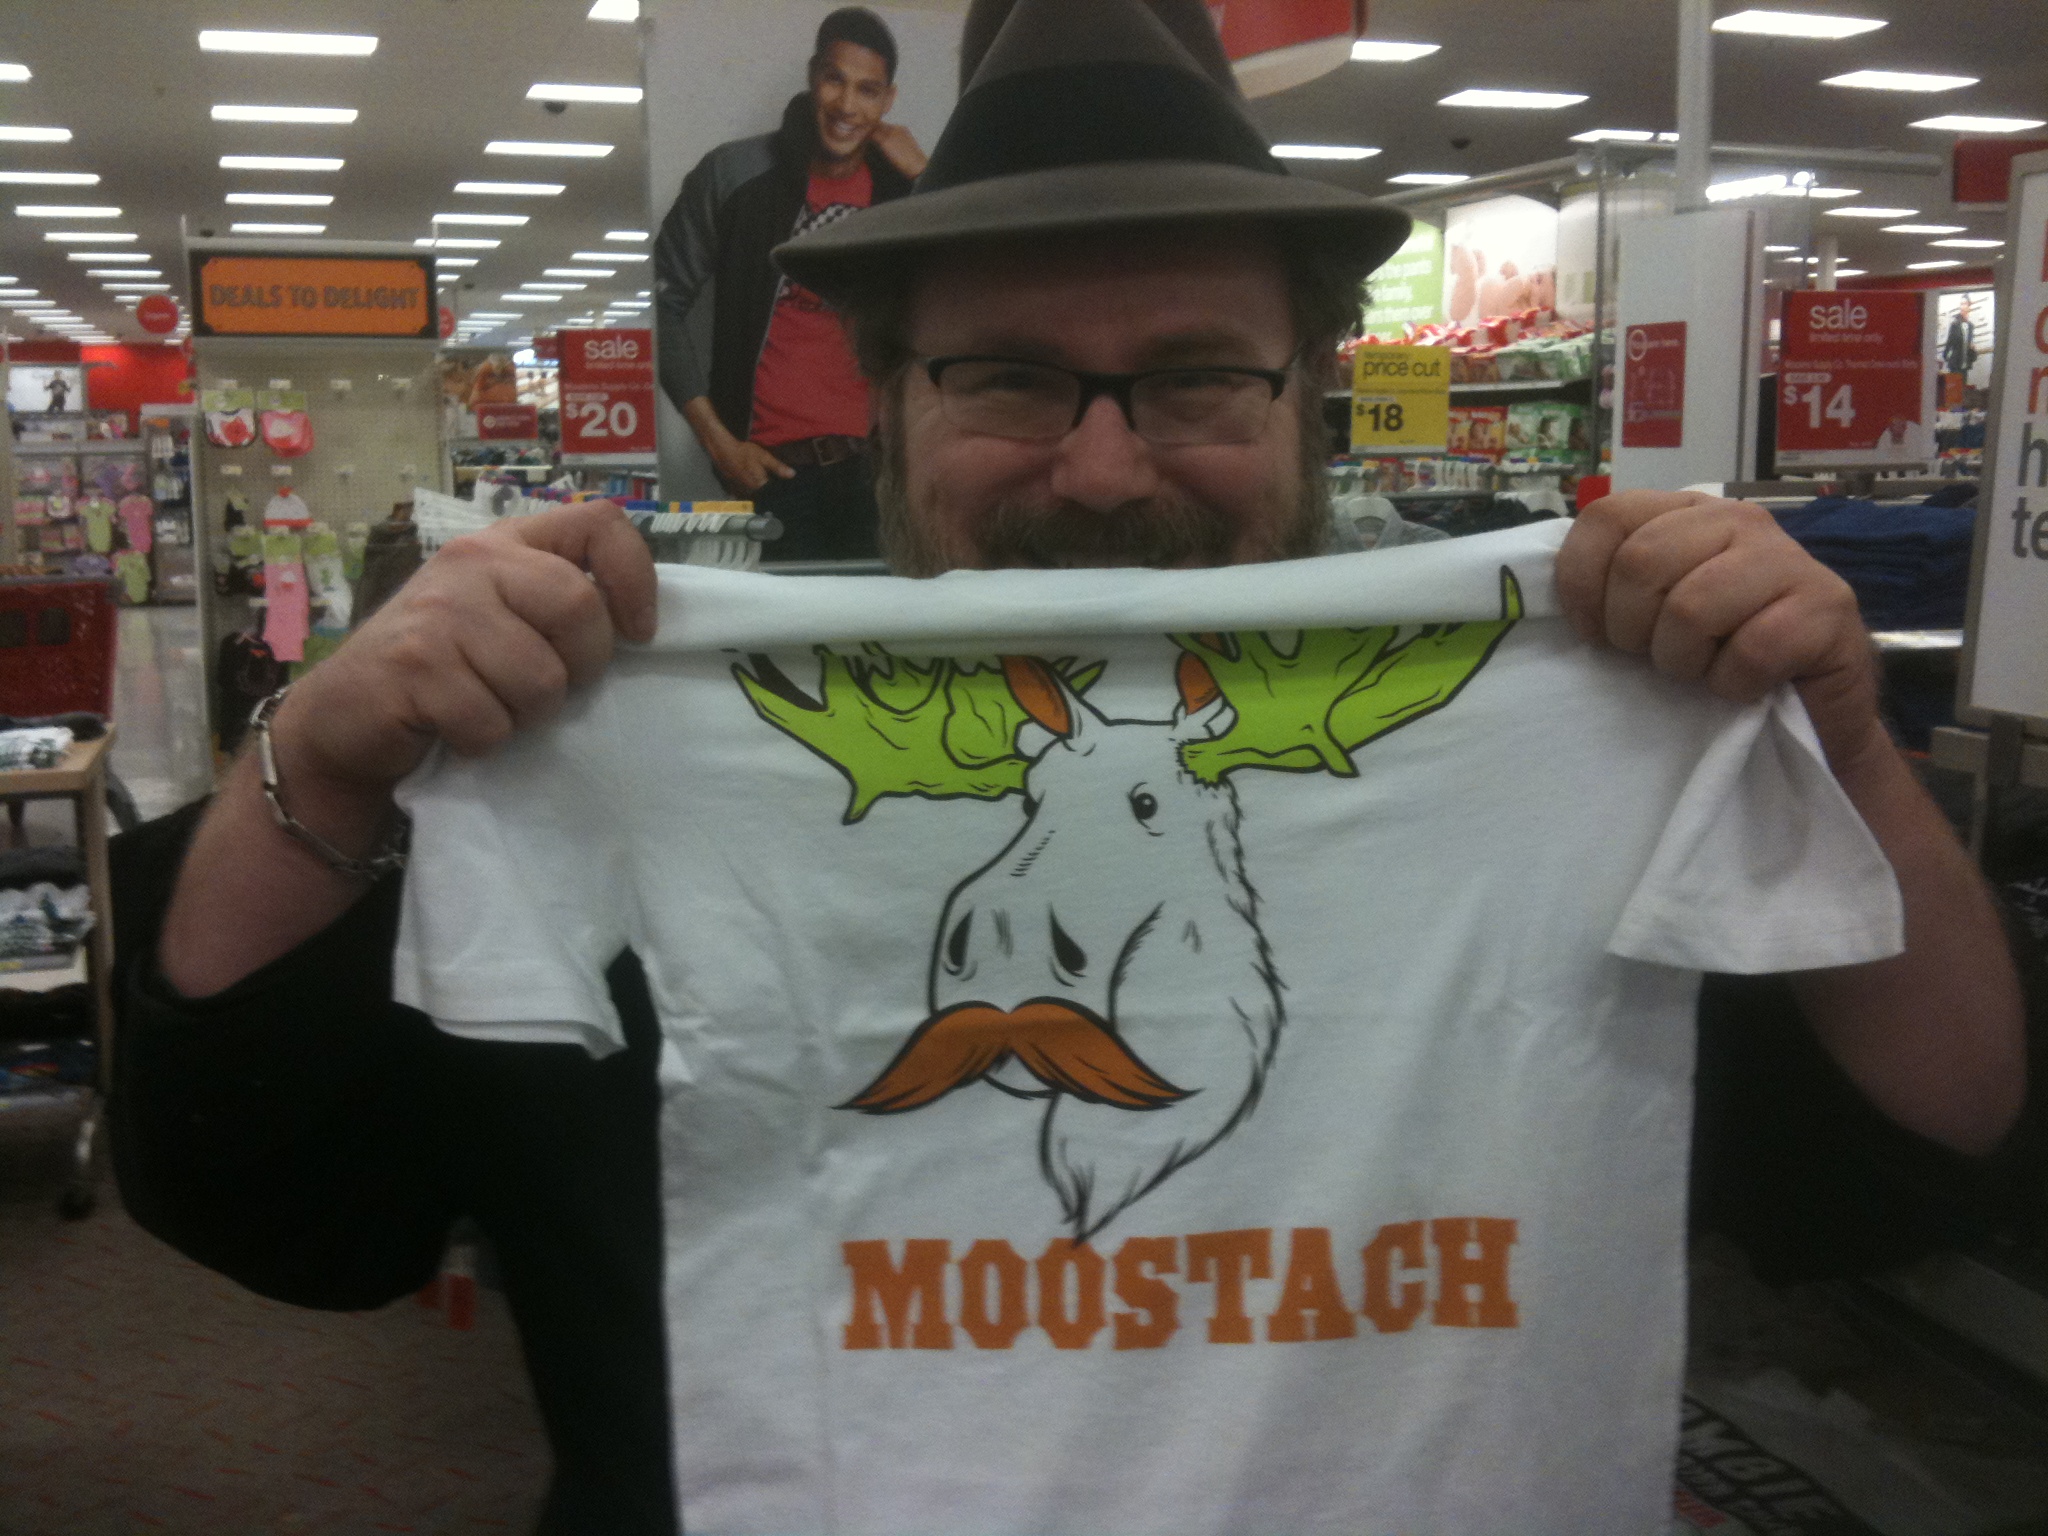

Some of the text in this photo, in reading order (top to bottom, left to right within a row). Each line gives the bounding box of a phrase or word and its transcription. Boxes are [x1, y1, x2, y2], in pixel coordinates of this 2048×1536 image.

[210, 284, 420, 310] DEALS TO DELIGHT
[1810, 298, 1868, 329] sale
[583, 335, 638, 359] sale
[1363, 359, 1442, 380] price cut
[565, 402, 638, 437] $20
[1356, 403, 1405, 433] $18
[1784, 383, 1857, 429] $14
[842, 1215, 1519, 1351] MOOSTACH
